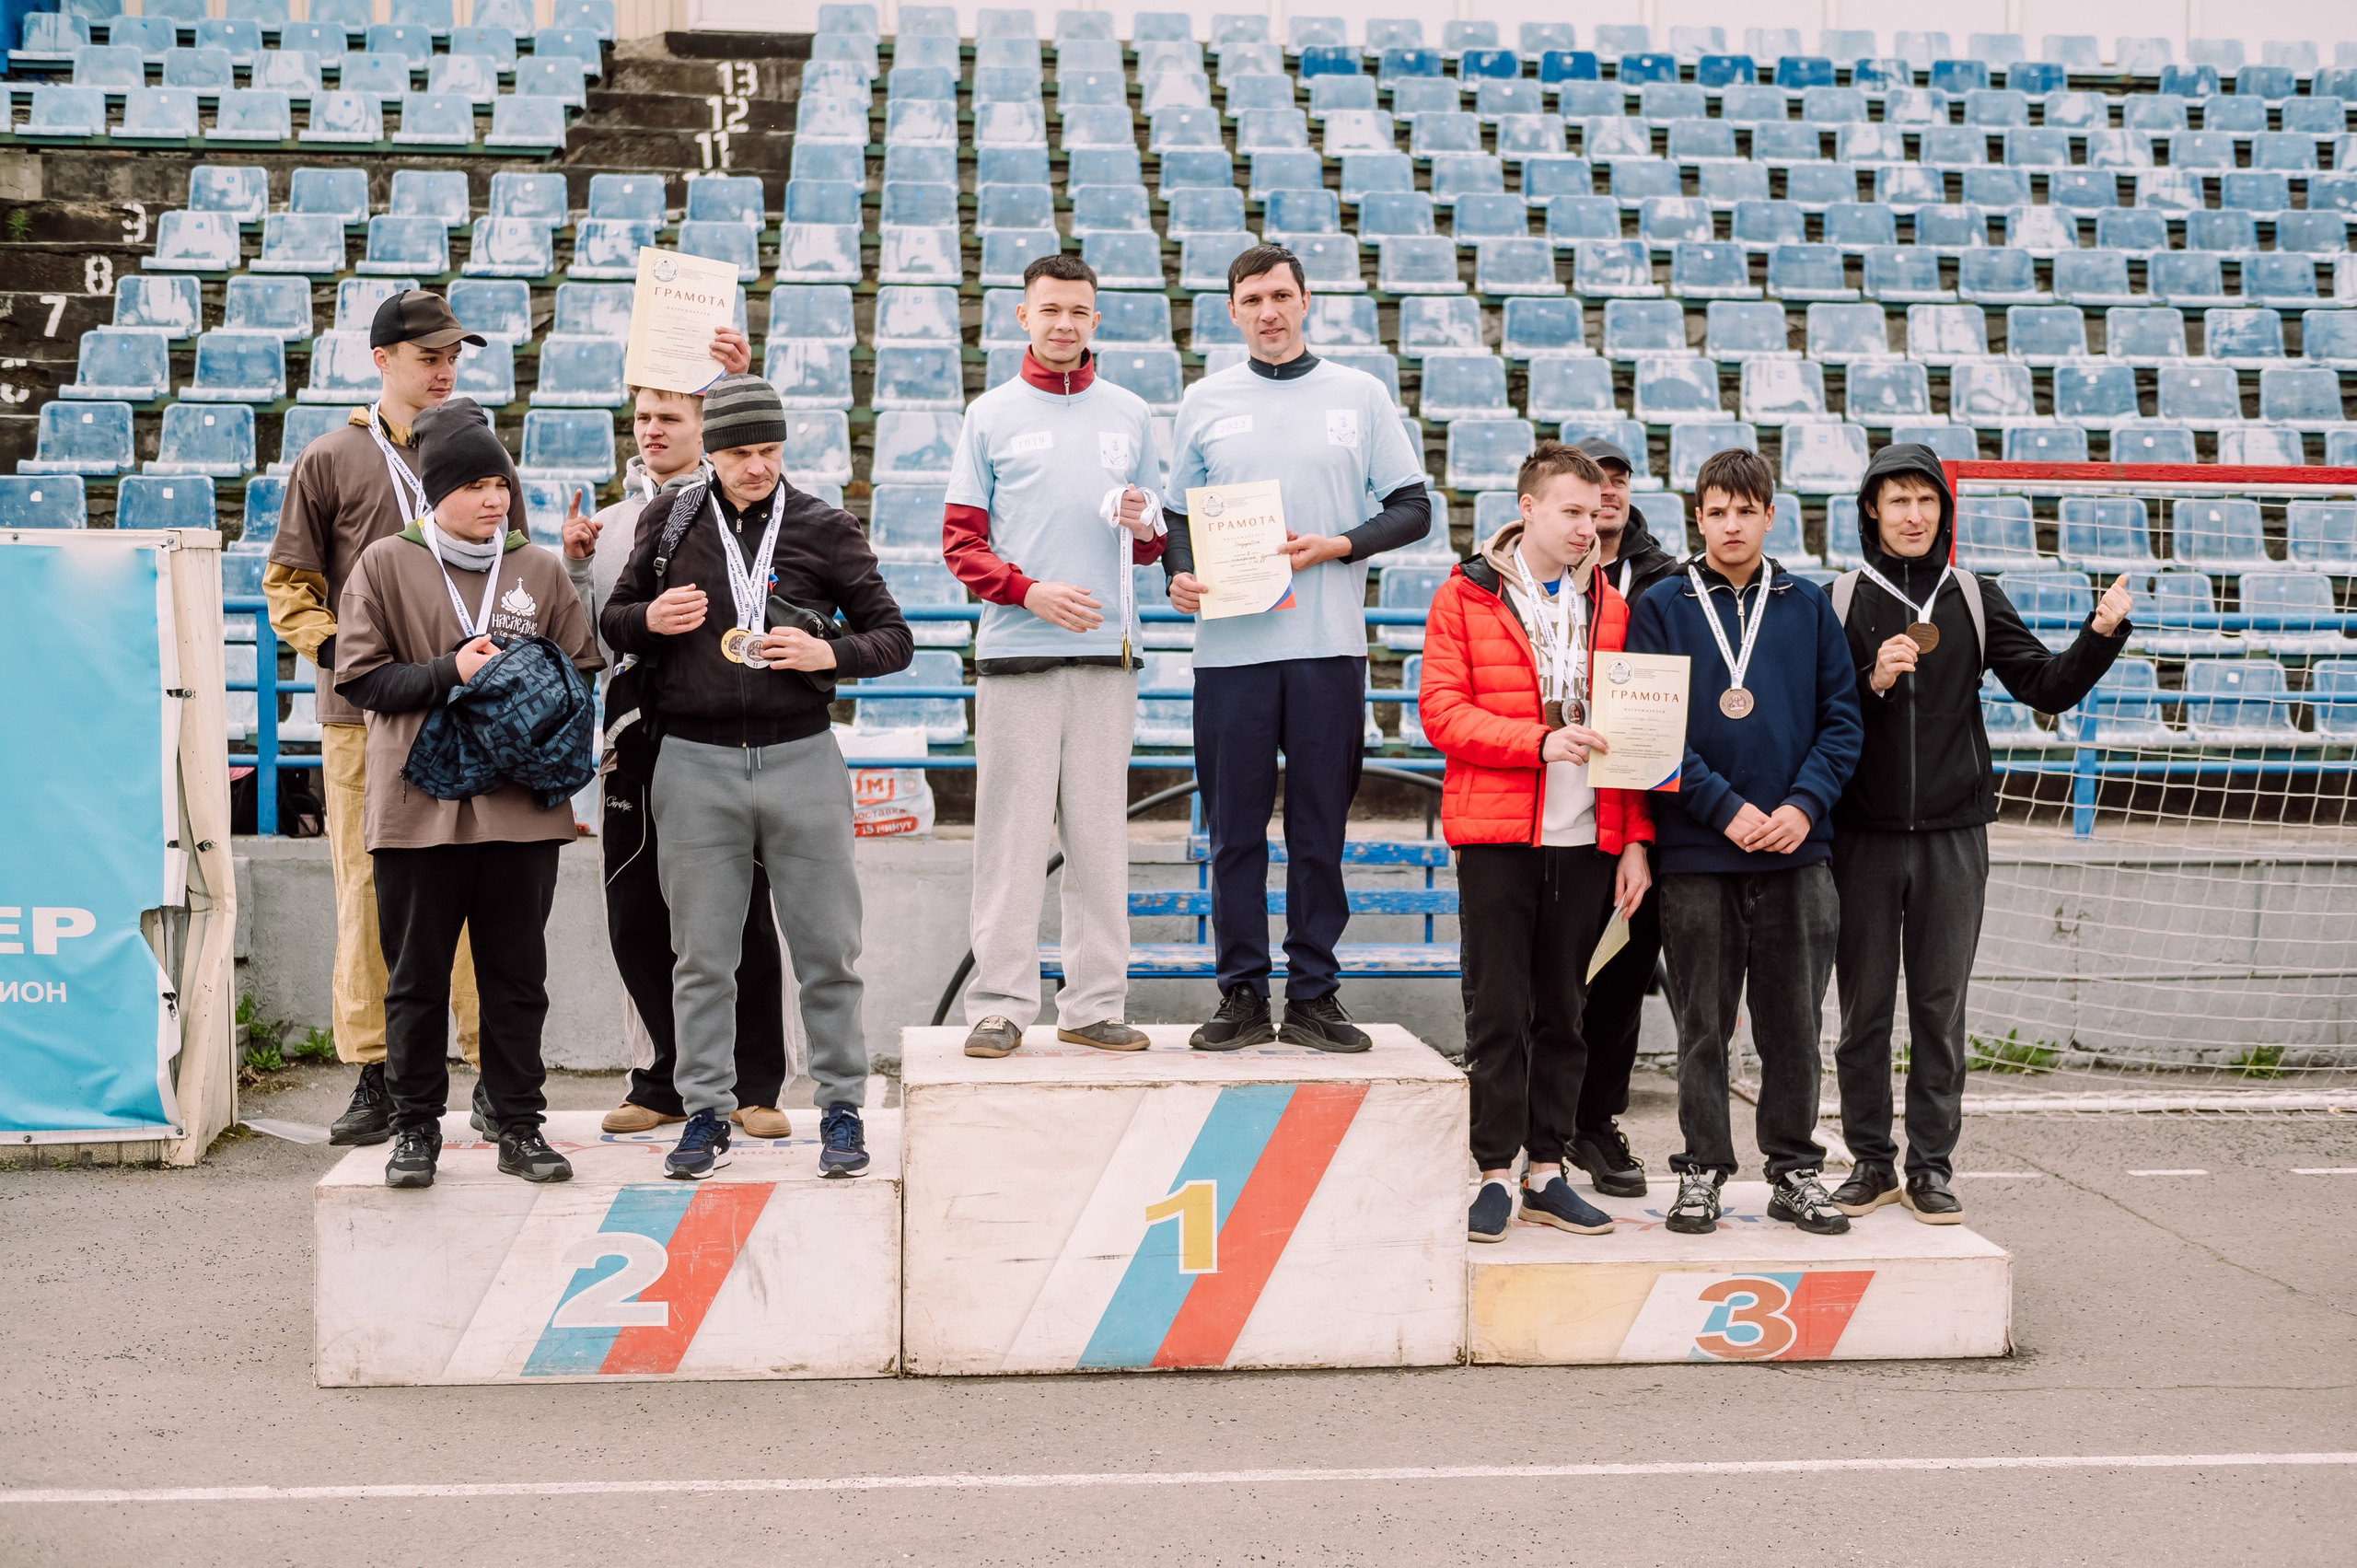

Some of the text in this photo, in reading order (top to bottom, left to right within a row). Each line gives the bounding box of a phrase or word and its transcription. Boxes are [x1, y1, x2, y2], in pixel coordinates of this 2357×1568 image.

[716, 61, 758, 96] 13
[705, 95, 749, 134] 12
[694, 130, 729, 169] 11
[85, 255, 113, 295] 8
[655, 286, 726, 308] ГРАМОТА
[40, 295, 67, 337] 7
[1220, 420, 1246, 433] 2022
[1018, 436, 1045, 448] 1019
[1208, 515, 1276, 532] ГРАМОТА
[727, 542, 737, 559] спорт»
[757, 584, 765, 609] схальный
[1611, 690, 1679, 703] ГРАМОТА
[862, 825, 874, 835] 15
[0, 981, 67, 1003] ИОН
[1145, 1179, 1218, 1274] 1
[552, 1231, 669, 1328] 2
[1694, 1274, 1797, 1362] 3
